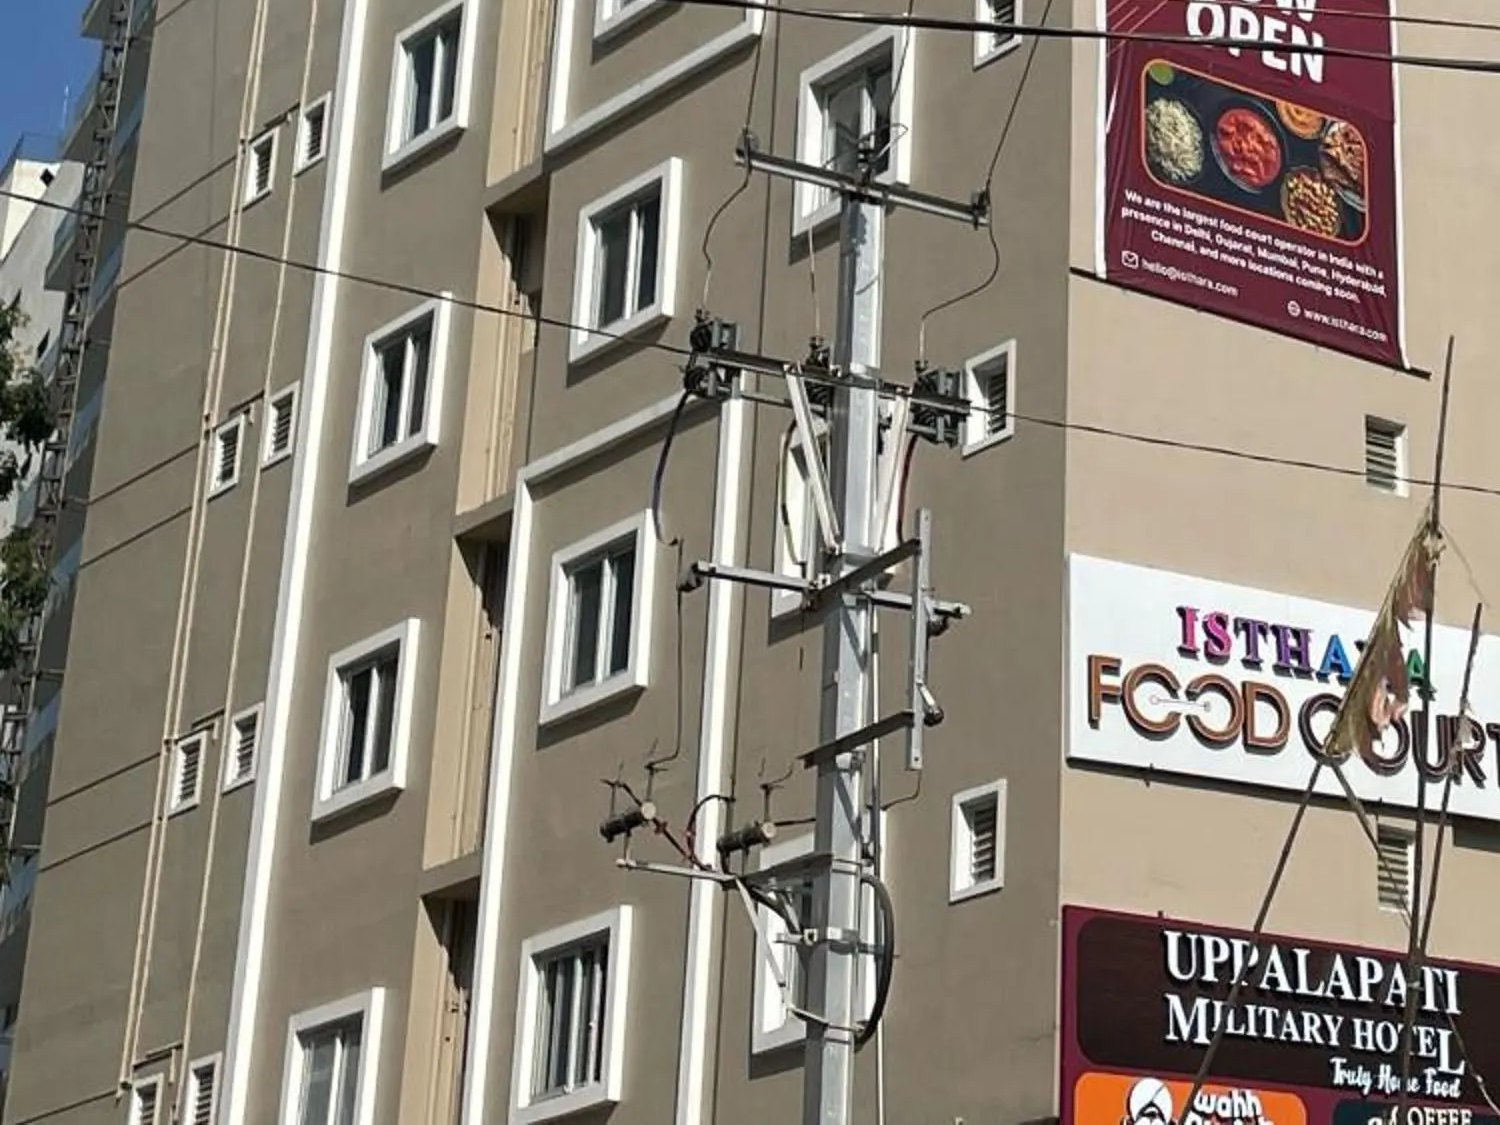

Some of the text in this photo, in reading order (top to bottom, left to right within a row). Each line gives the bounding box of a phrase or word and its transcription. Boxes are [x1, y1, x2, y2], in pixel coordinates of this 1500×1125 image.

[1121, 206, 1171, 231] presence
[1172, 220, 1183, 234] in
[1184, 223, 1213, 244] Delhi,
[1331, 268, 1387, 298] Hyderabad,
[1124, 188, 1142, 205] We
[1144, 197, 1162, 212] are
[1163, 202, 1181, 217] the
[1182, 206, 1219, 228] largest
[1219, 219, 1243, 236] food
[1245, 228, 1273, 246] court
[1273, 238, 1317, 258] operator
[1317, 250, 1329, 263] in
[1329, 252, 1354, 270] India
[1355, 262, 1378, 278] with
[1199, 246, 1219, 261] and
[1219, 253, 1247, 269] more
[1247, 259, 1294, 283] locations
[1295, 276, 1333, 297] coming
[1176, 605, 1435, 695] ISTHAA
[1088, 654, 1290, 755] FOOD
[1163, 930, 1463, 1016] UPPALAPATI
[1165, 994, 1466, 1075] MILITARY HOEL
[1194, 1089, 1263, 1118] wahh
[1330, 1057, 1372, 1095] Truly
[1423, 1067, 1462, 1099] Food
